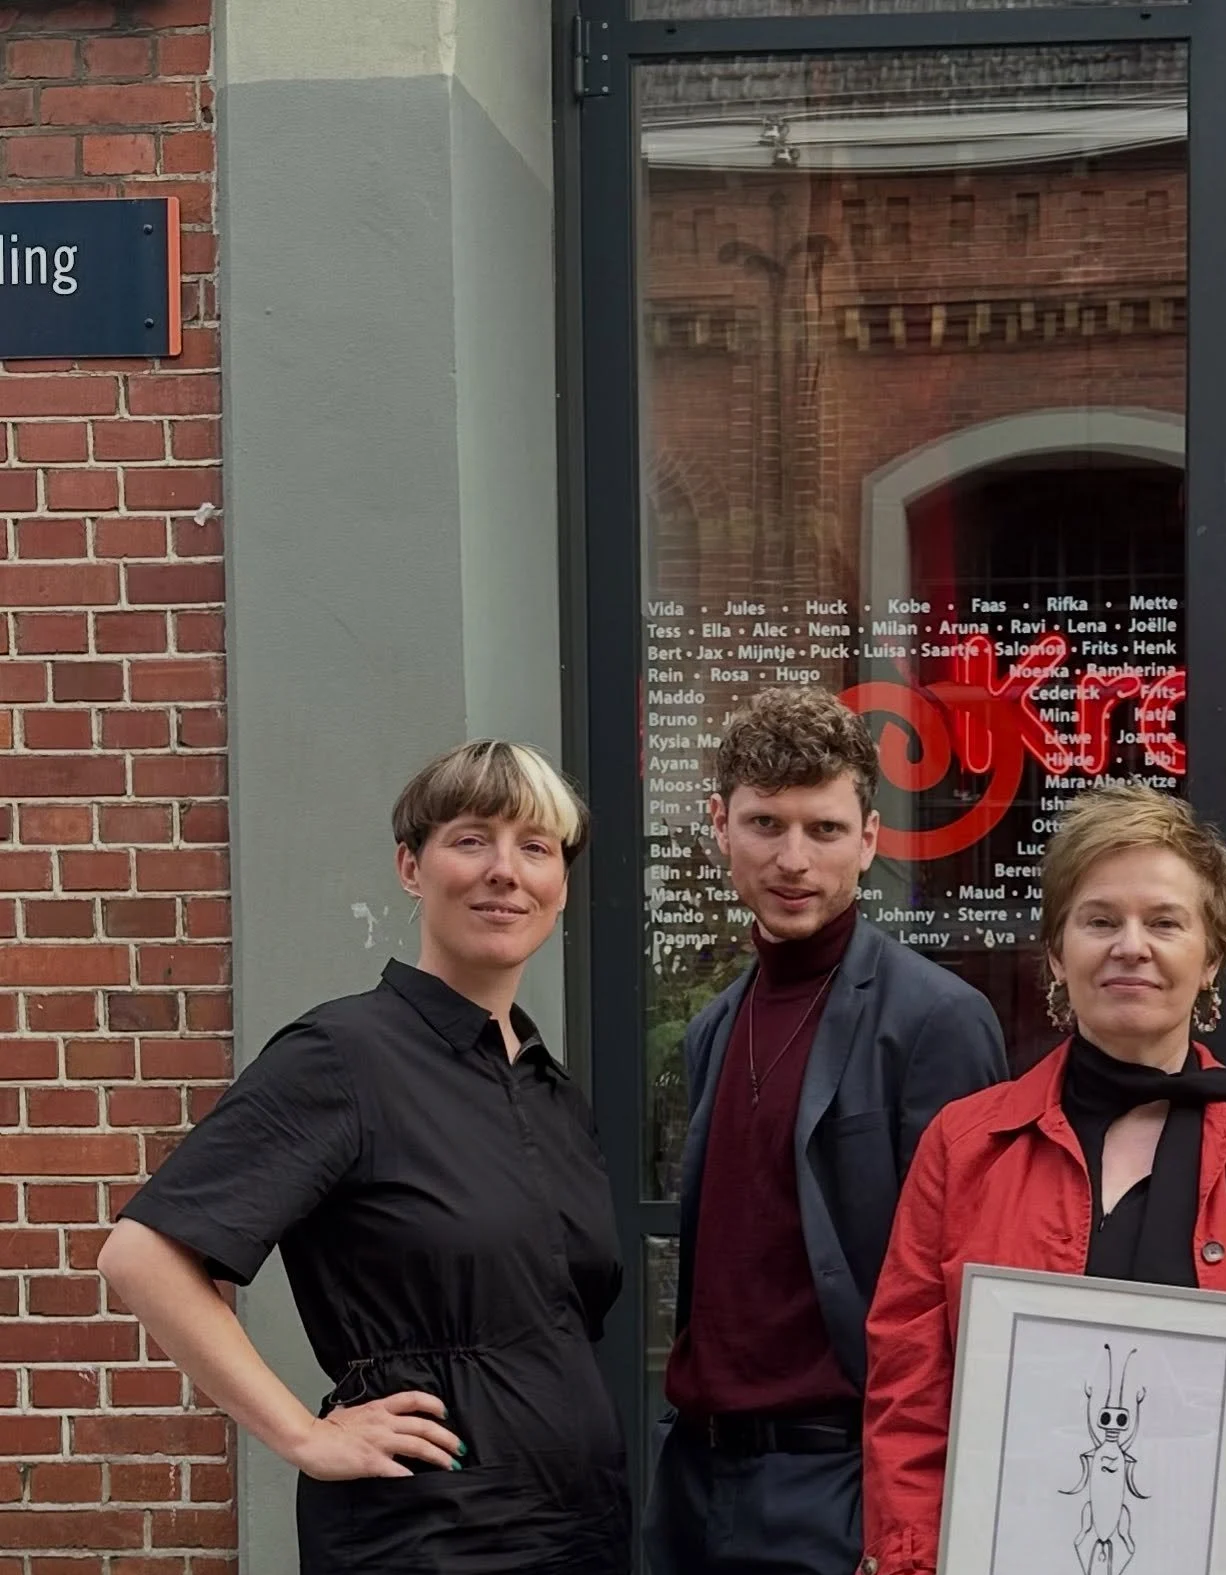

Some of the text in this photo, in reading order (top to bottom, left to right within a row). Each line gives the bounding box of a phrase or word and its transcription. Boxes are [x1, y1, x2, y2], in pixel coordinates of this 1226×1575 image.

[647, 596, 1178, 616] Vida Jules Huck Kobe Faas Rifka Mette
[647, 618, 1177, 638] Tess Ella Alec Nena Milan Aruna Ravi Lena Joëlle
[648, 639, 1177, 663] Bert Jax Mijntje Puck Luisa Saartje Salomon Frits Henk
[648, 667, 820, 684] Rein Rosa Hugo
[1086, 662, 1177, 677] Bamberina
[648, 690, 705, 705] Maddo
[1028, 684, 1177, 700] Cederick Frits
[649, 712, 697, 726] Bruno
[1040, 707, 1177, 726] Mina Katja
[649, 734, 689, 750] Kysia
[1116, 729, 1177, 744] Joanne
[649, 756, 698, 772] Ayana
[1046, 751, 1177, 767] Hidde Bibi
[650, 778, 693, 793] Moos
[1045, 775, 1085, 790] Mara
[1093, 774, 1126, 789] Abe
[650, 799, 680, 814] Pim
[650, 822, 669, 837] Ea
[650, 844, 692, 858] Bube
[650, 865, 721, 880] Elin Jiri
[650, 887, 691, 902] Mara
[705, 886, 739, 901] Tess
[959, 885, 1005, 900] Maud
[651, 909, 704, 924] Nando
[875, 907, 935, 925] Johnny
[958, 907, 1007, 921] Sterre
[653, 929, 1016, 949] Dagmar Lenny Ava
